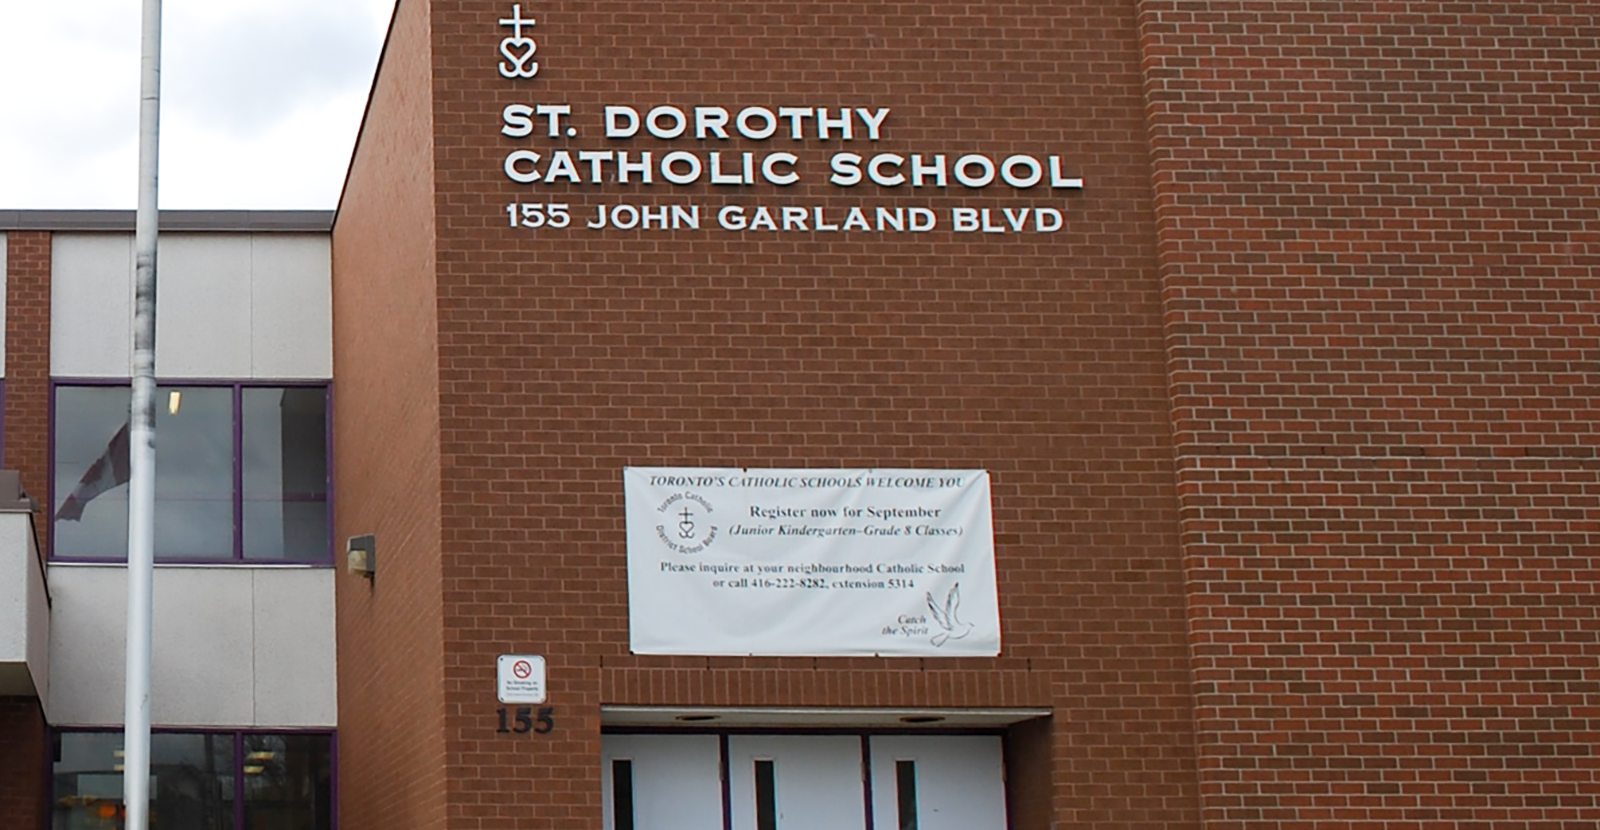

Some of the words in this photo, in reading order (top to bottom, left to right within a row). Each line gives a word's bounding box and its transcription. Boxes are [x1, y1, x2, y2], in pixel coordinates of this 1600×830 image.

[501, 104, 578, 138] ST.
[604, 105, 891, 140] DOROTHY
[503, 150, 800, 185] CATHOLIC
[829, 152, 1084, 189] SCHOOL
[506, 203, 571, 229] 155
[587, 204, 701, 230] JOHN
[717, 205, 937, 232] GARLAND
[952, 207, 1064, 233] BLVD
[650, 475, 726, 488] TORONTO'S
[728, 476, 798, 488] CATHOLIC
[800, 476, 862, 488] SCHOOLS
[866, 477, 935, 488] WELCOME
[938, 477, 965, 488] YOU
[656, 492, 684, 513] Toronto
[684, 491, 714, 514] Catholic
[750, 505, 807, 519] Register
[810, 507, 838, 518] now
[842, 506, 863, 518] for
[866, 506, 941, 520] September
[728, 524, 774, 536] (Junior
[903, 525, 912, 536] 8
[915, 525, 964, 537] Classes)
[656, 524, 679, 551] District
[678, 543, 704, 554] School
[701, 525, 718, 547] Board
[660, 561, 696, 572] Please
[699, 562, 740, 575] inquire
[743, 564, 754, 573] at
[757, 564, 784, 575] your
[787, 563, 873, 575] neighbourhood
[876, 563, 924, 574] Catholic
[927, 563, 965, 574] School
[712, 579, 725, 588] or
[728, 578, 748, 588] call
[832, 578, 885, 589] extension
[887, 578, 915, 589] 5314
[897, 614, 927, 625] Catch
[882, 625, 898, 636] the
[901, 625, 929, 636] Spirit
[496, 707, 554, 734] 155
